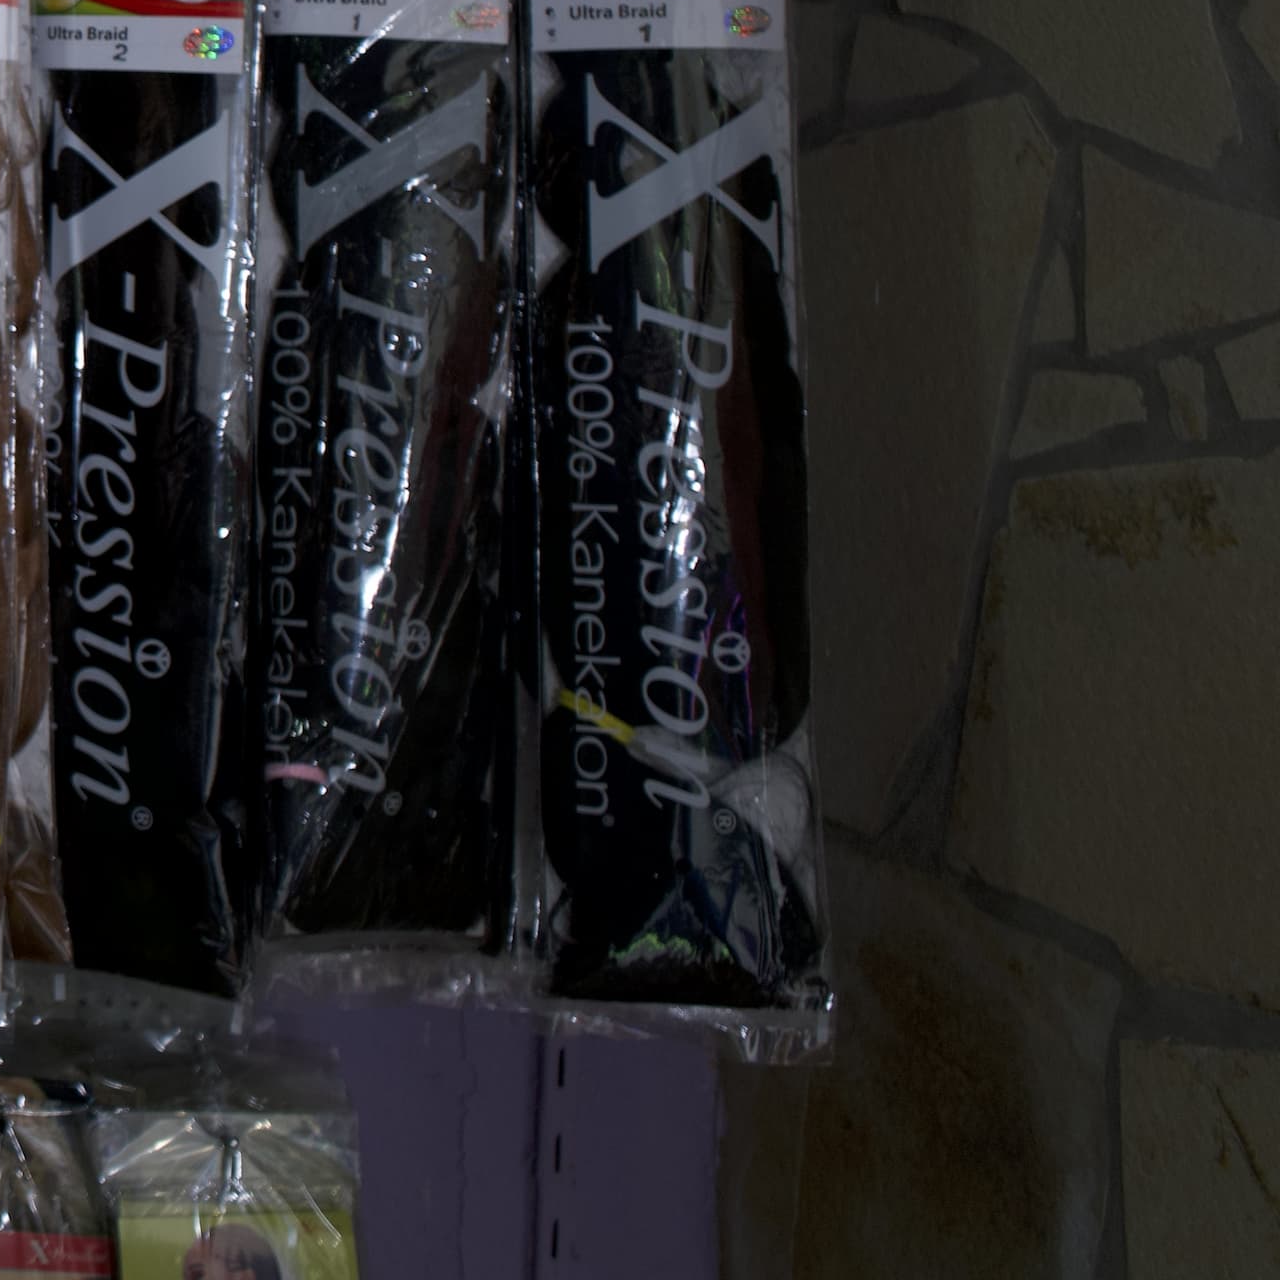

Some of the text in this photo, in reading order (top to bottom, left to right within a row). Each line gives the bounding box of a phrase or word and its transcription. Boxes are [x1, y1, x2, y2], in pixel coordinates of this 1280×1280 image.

[48, 26, 128, 40] Ultra Braid
[113, 45, 128, 61] 2
[569, 3, 666, 19] Ultra Braid
[638, 24, 651, 42] 1
[269, 281, 311, 445] 100%
[297, 63, 486, 795] X-Pression
[586, 72, 781, 809] X-Pression
[51, 100, 229, 805] X-Pression
[565, 315, 623, 817] 100% Kanekalon
